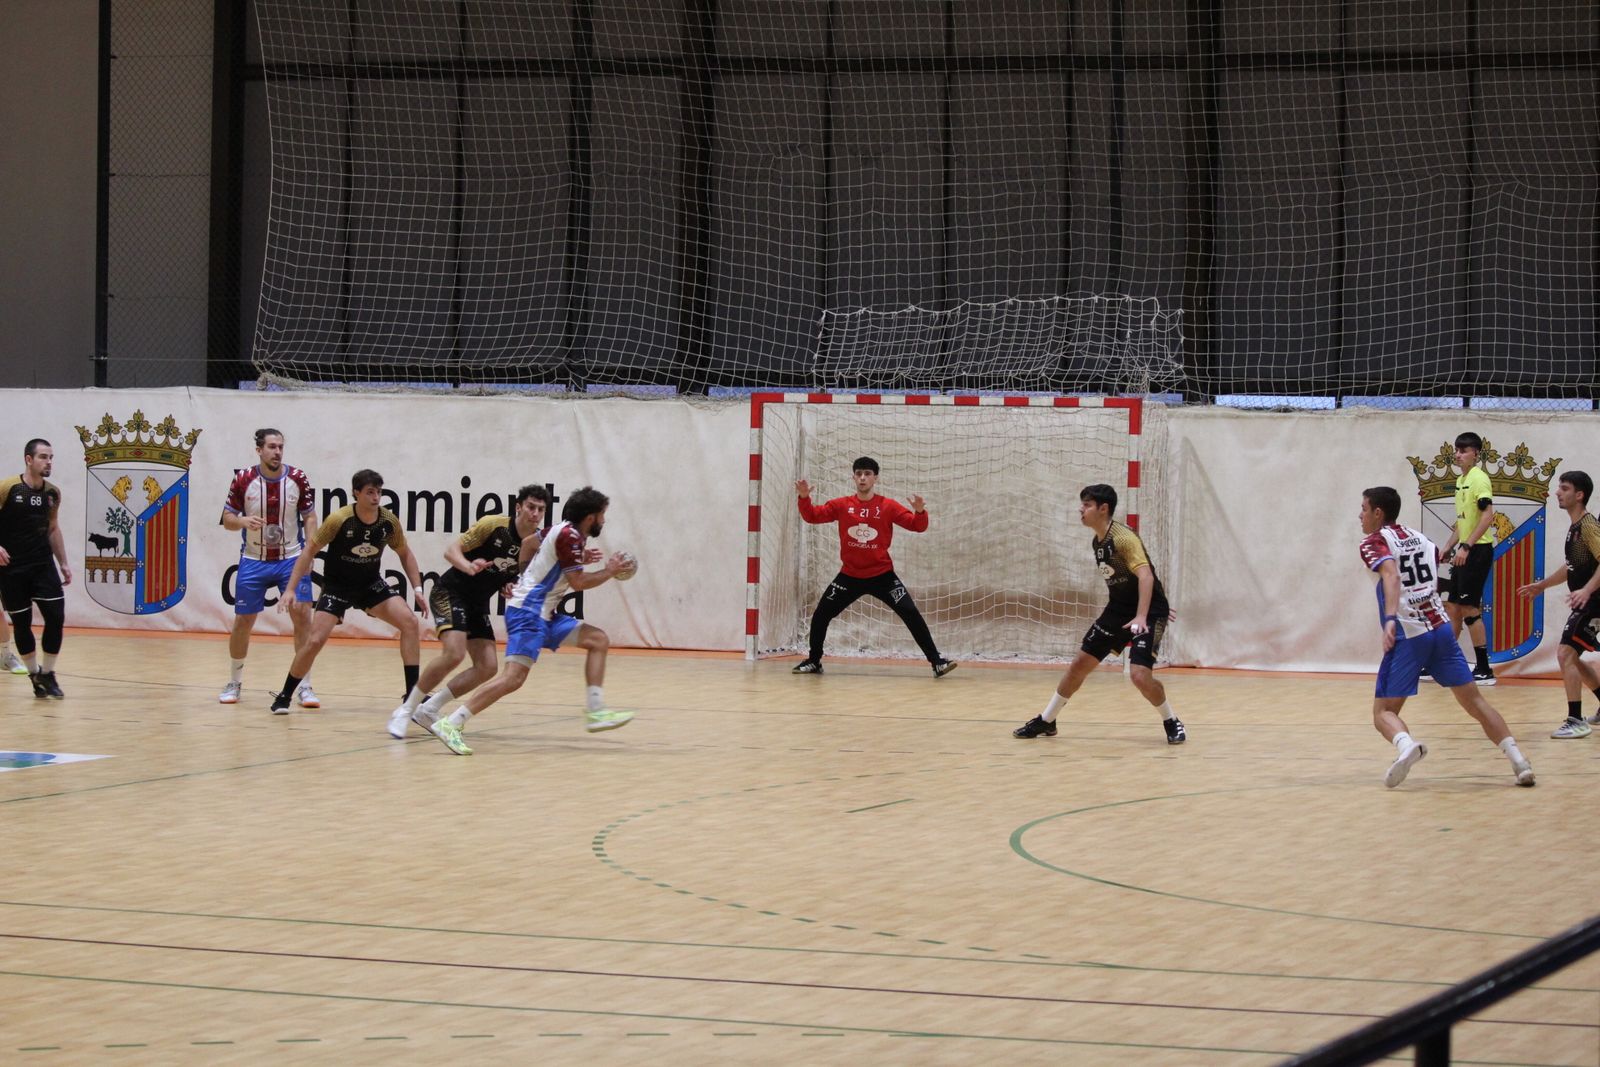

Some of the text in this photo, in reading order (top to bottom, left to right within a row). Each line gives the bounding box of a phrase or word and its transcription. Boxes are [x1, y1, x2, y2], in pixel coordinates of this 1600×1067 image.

[30, 495, 42, 506] 68
[860, 508, 869, 517] 21
[364, 530, 371, 540] 2
[508, 545, 520, 556] 27
[1399, 551, 1433, 587] 56
